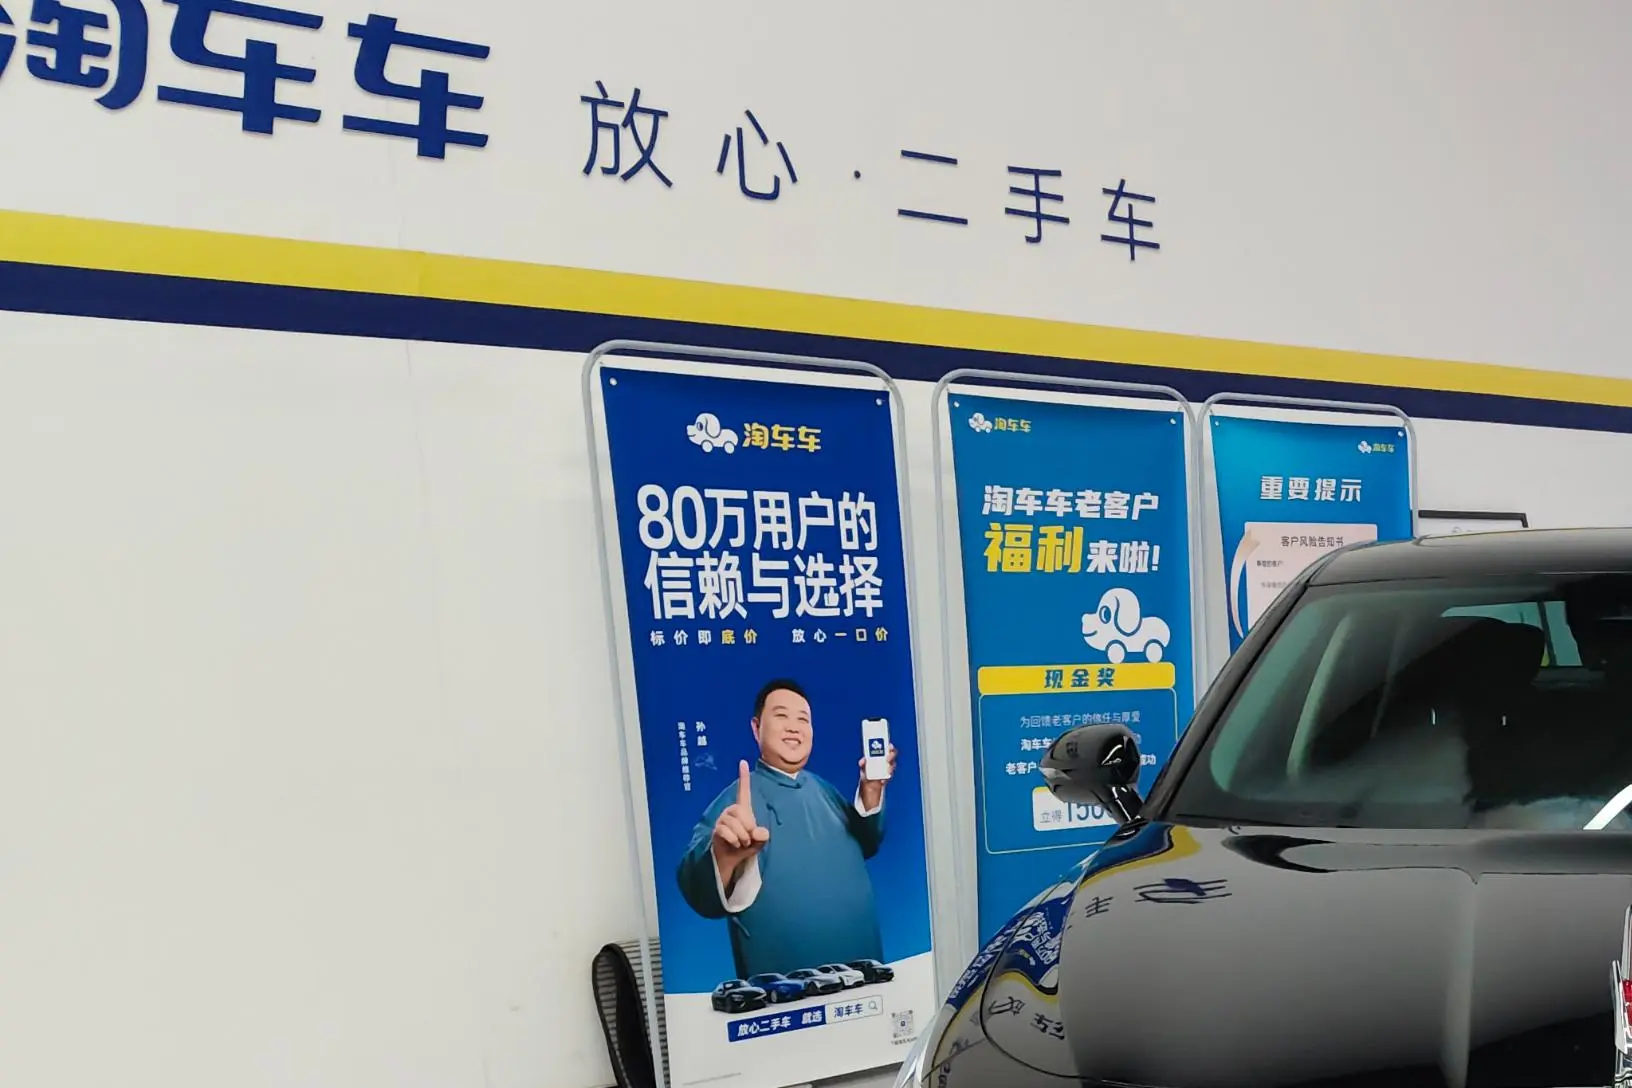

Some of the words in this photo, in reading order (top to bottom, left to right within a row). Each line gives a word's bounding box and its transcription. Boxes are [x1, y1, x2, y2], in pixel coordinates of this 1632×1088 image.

[742, 422, 822, 453] 淘车车
[994, 417, 1032, 433] 淘车车
[982, 485, 1160, 521] 淘车车老客户
[1260, 475, 1363, 503] 重要提示
[637, 484, 878, 551] 80万用户的
[643, 551, 884, 620] 信赖与选择
[650, 629, 758, 646] 标价即底价
[791, 627, 889, 643] 放心一口价
[1044, 667, 1117, 689] 现金奖
[737, 1016, 792, 1037] 放心二手车
[833, 1003, 864, 1018] 淘车车
